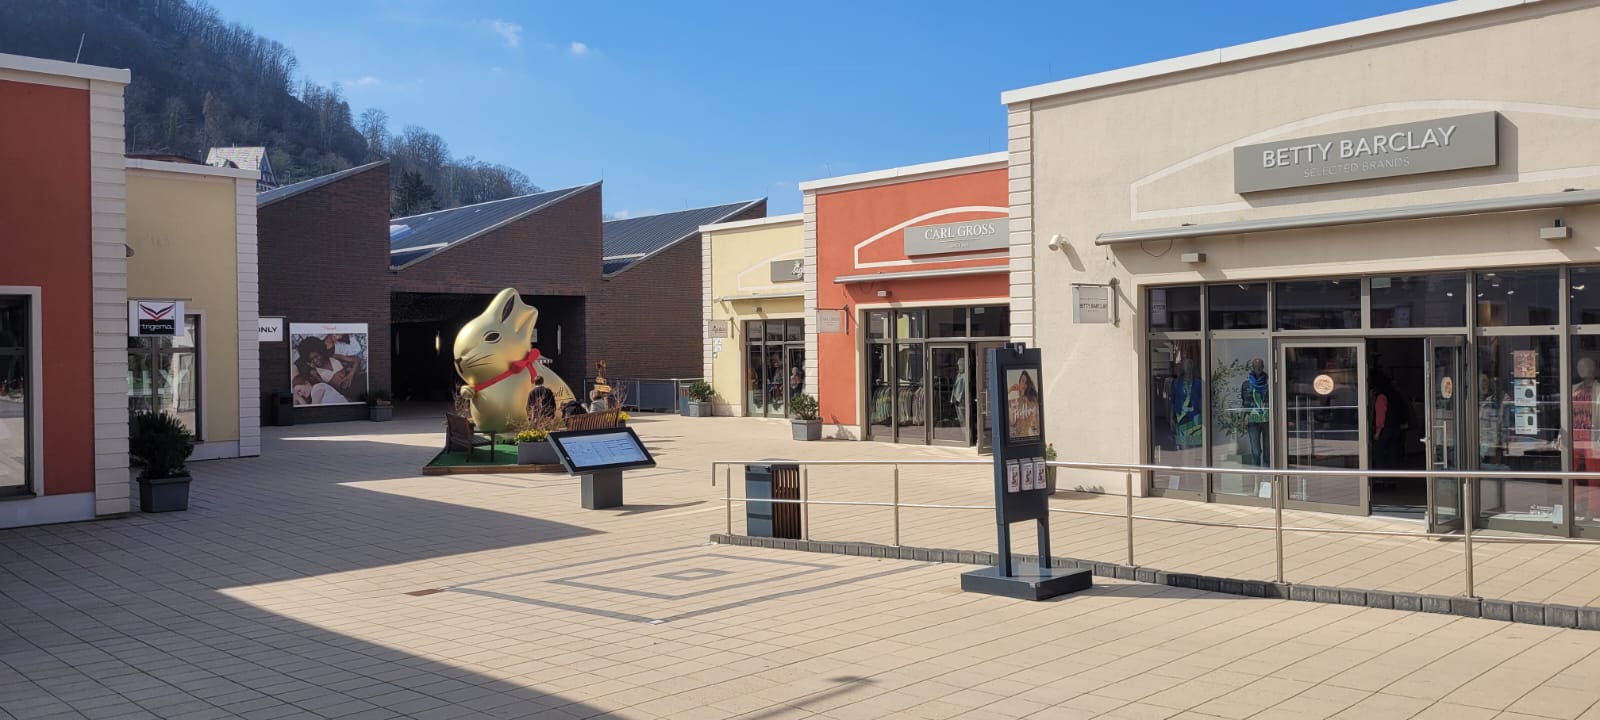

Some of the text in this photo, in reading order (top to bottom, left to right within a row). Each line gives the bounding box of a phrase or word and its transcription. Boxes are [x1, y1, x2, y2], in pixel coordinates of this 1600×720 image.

[1263, 125, 1457, 168] BETTY BARCLAY
[1303, 156, 1410, 178] SELECTED BRANDS
[924, 223, 996, 240] CARL GROSS
[142, 323, 176, 332] trigema
